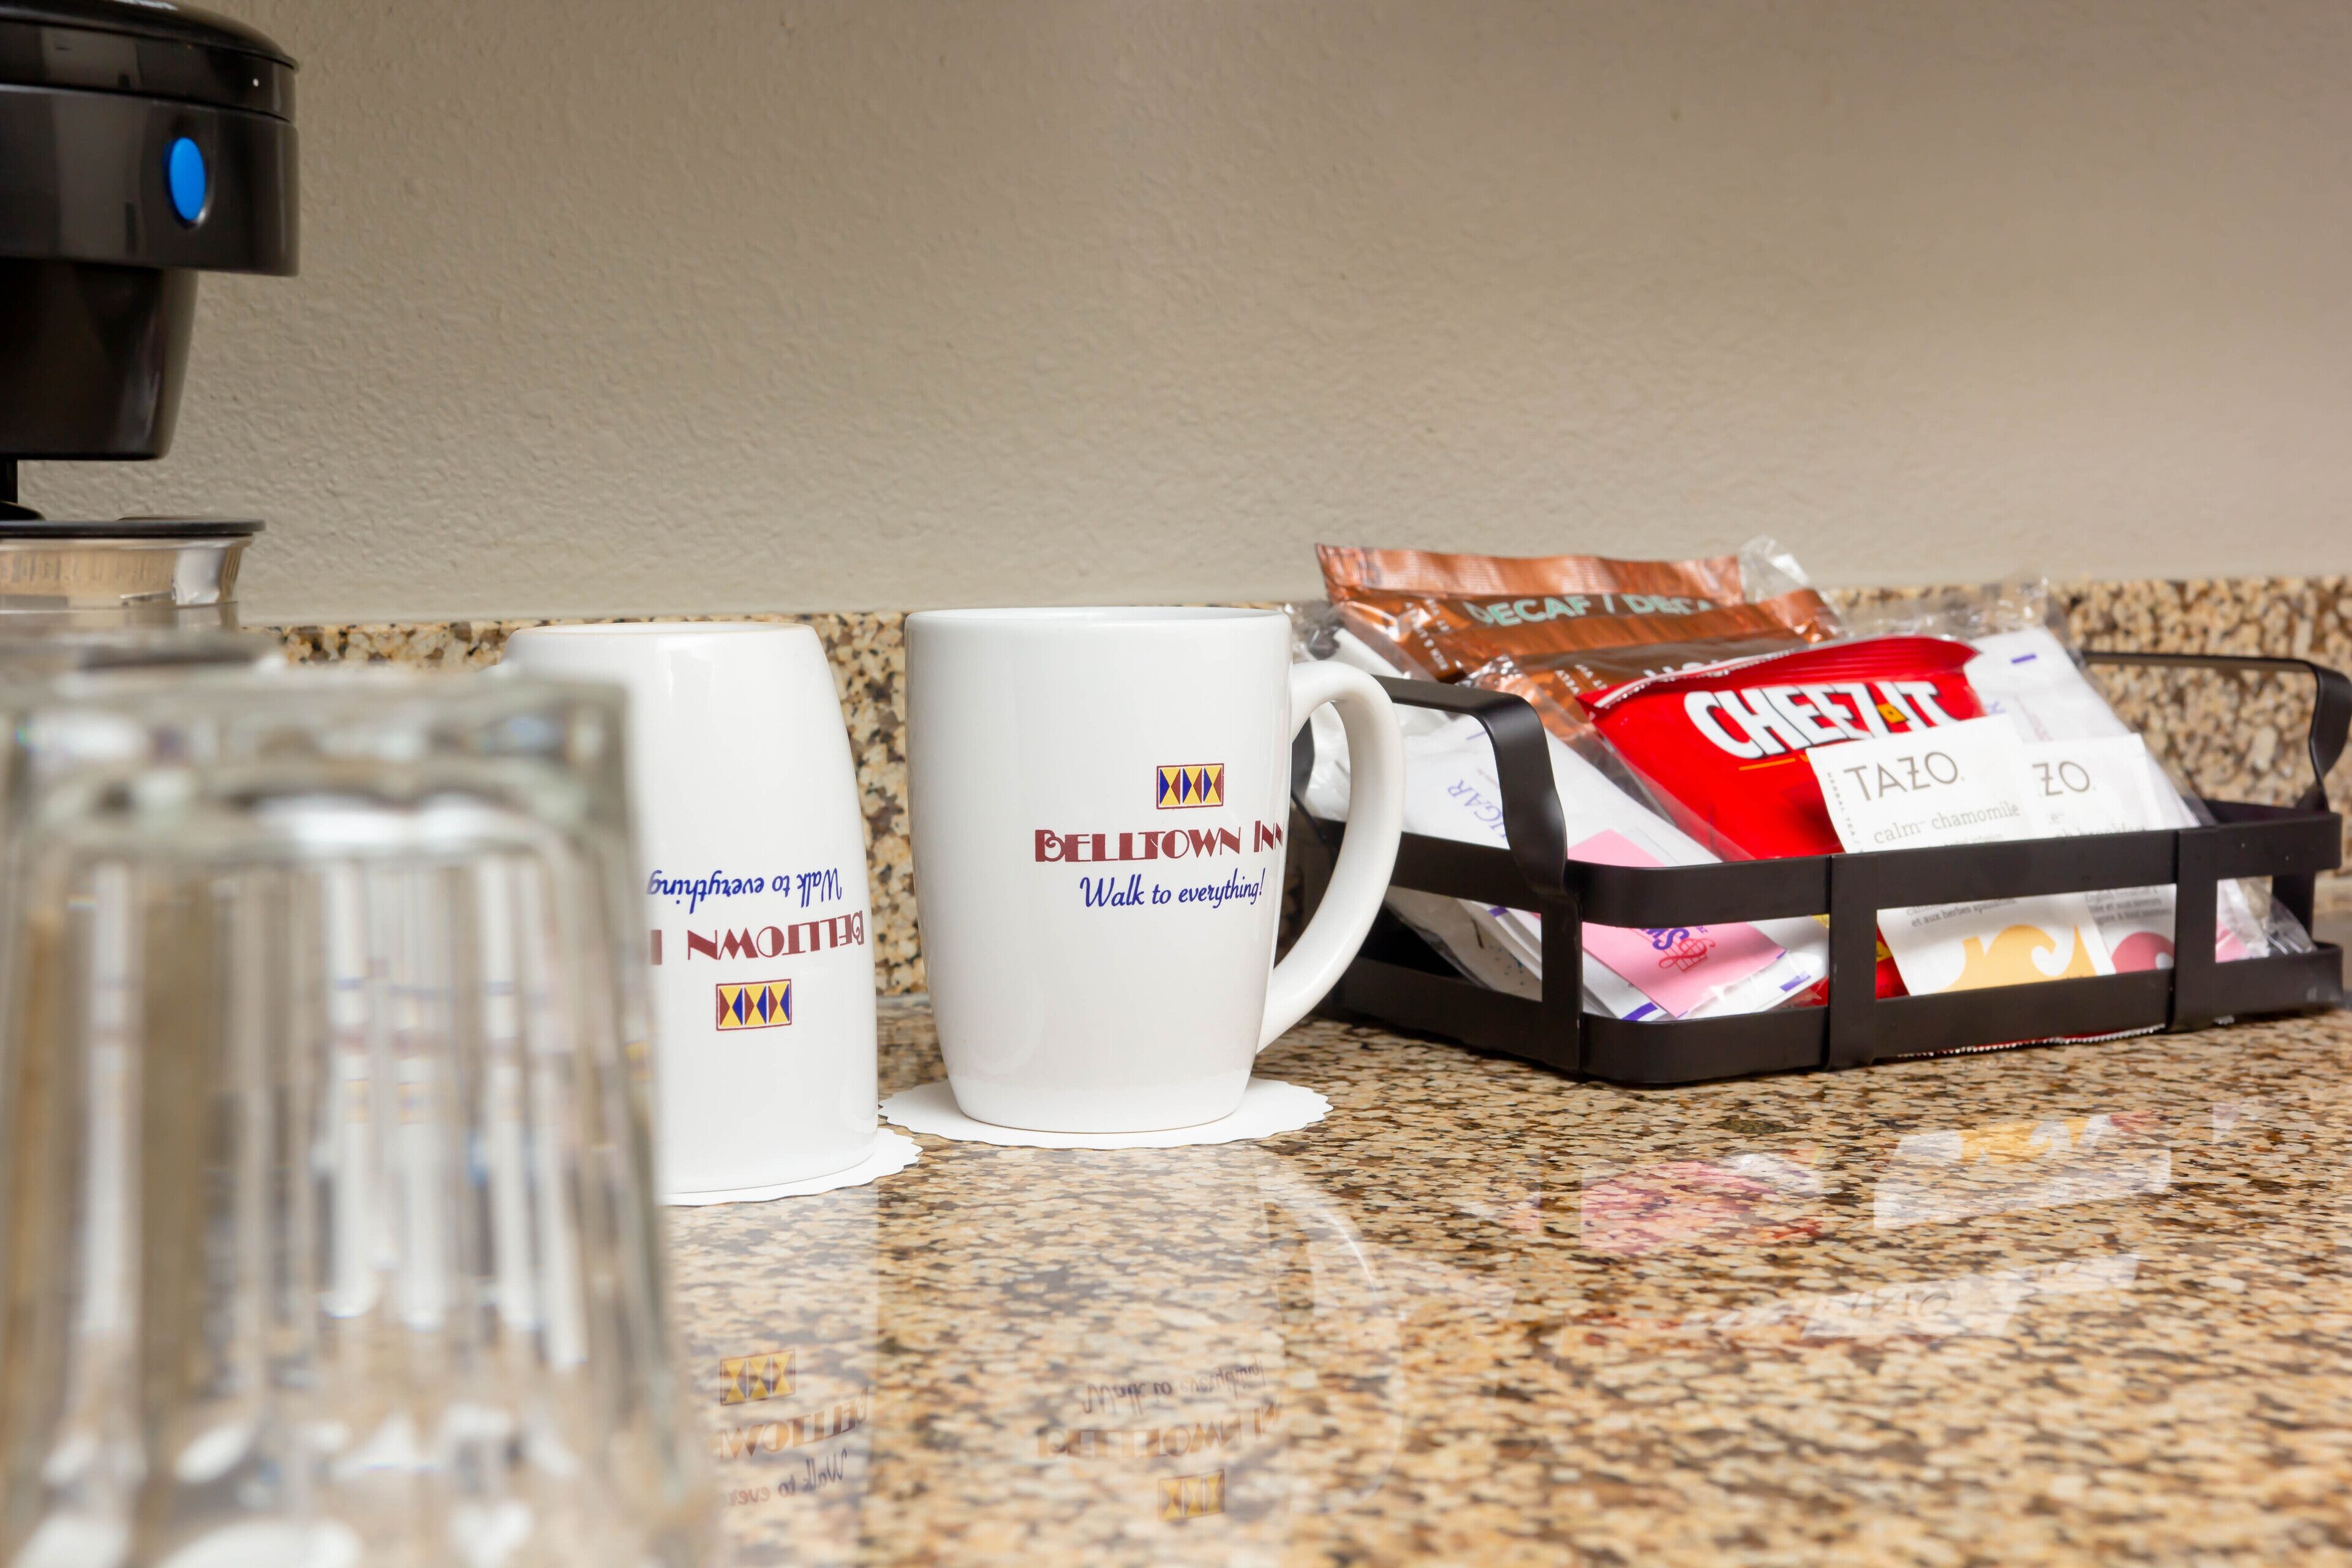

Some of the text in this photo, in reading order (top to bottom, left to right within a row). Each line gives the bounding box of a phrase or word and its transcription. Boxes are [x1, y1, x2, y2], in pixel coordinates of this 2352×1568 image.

[2033, 760, 2090, 796] ZO
[1447, 779, 1506, 839] GAR
[1931, 801, 2020, 831] chamomile
[1035, 825, 1241, 862] BELLTOWN
[772, 875, 791, 898] to
[797, 867, 842, 908] Walk
[1080, 867, 1266, 908] Walk to everything!
[687, 910, 865, 961] BELLTOWN
